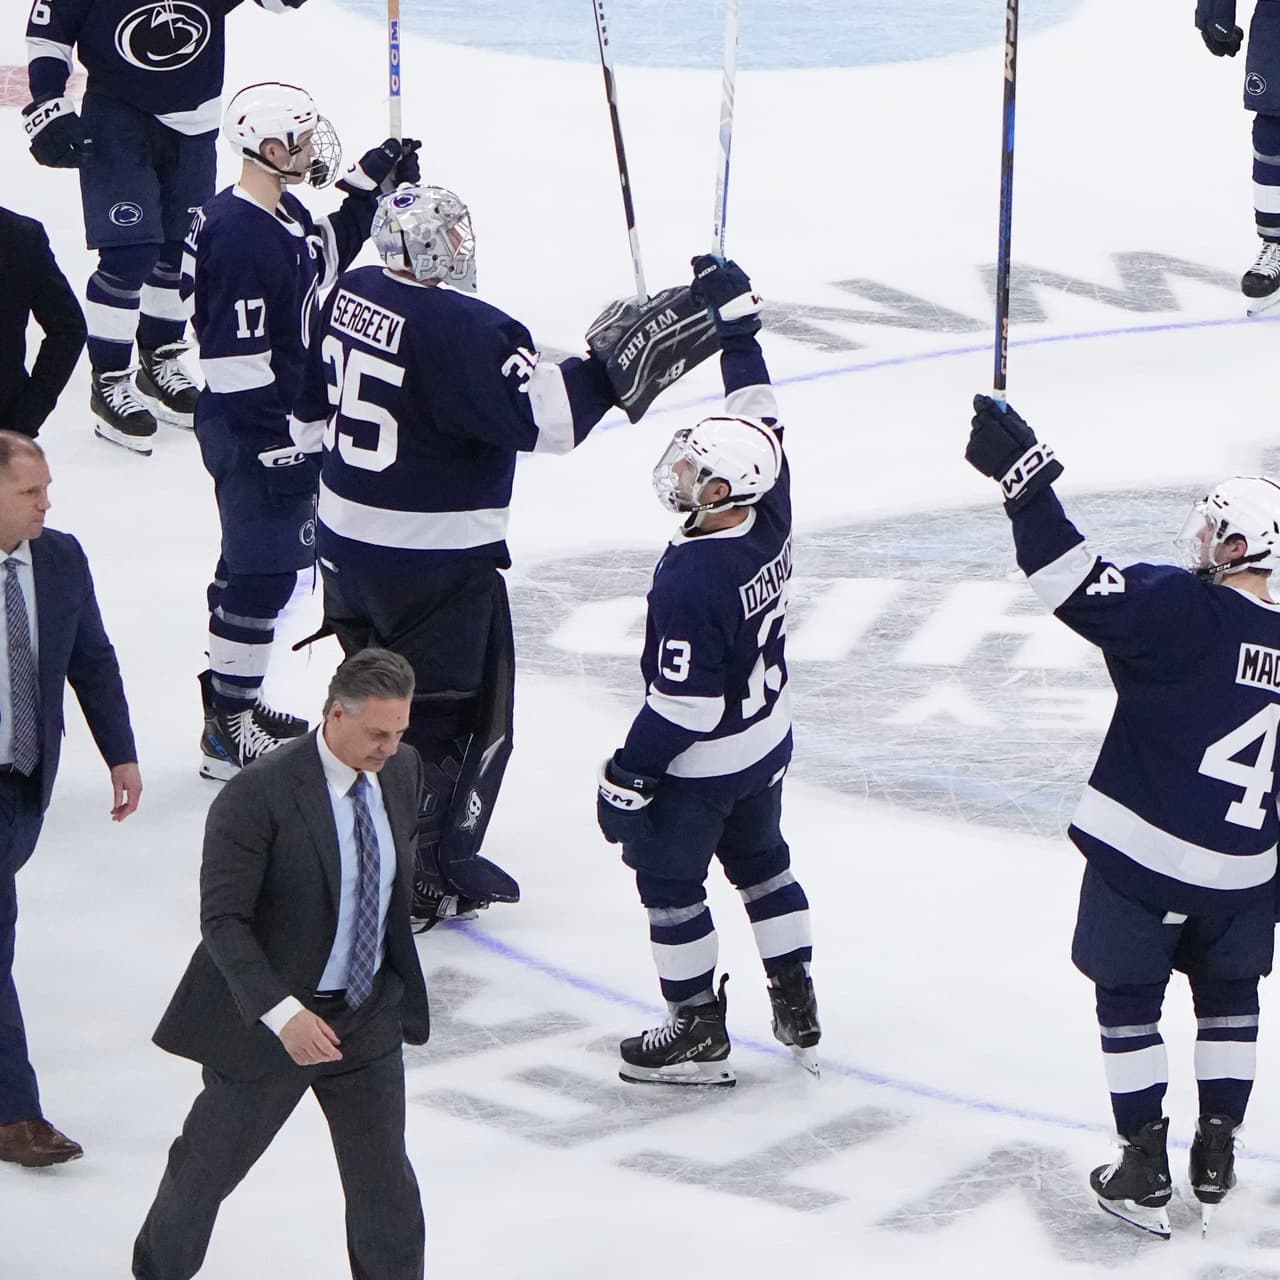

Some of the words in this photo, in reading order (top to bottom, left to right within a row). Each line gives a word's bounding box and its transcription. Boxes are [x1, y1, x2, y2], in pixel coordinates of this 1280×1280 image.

[389, 20, 400, 97] CCM
[25, 102, 61, 135] CCM
[416, 254, 469, 281] PSU
[233, 298, 265, 339] 17
[332, 294, 401, 354] SERGEEV
[643, 308, 680, 341] WE
[616, 338, 647, 371] ARE
[1086, 565, 1125, 596] 4
[658, 639, 690, 682] 3
[666, 1037, 712, 1065] CCM
